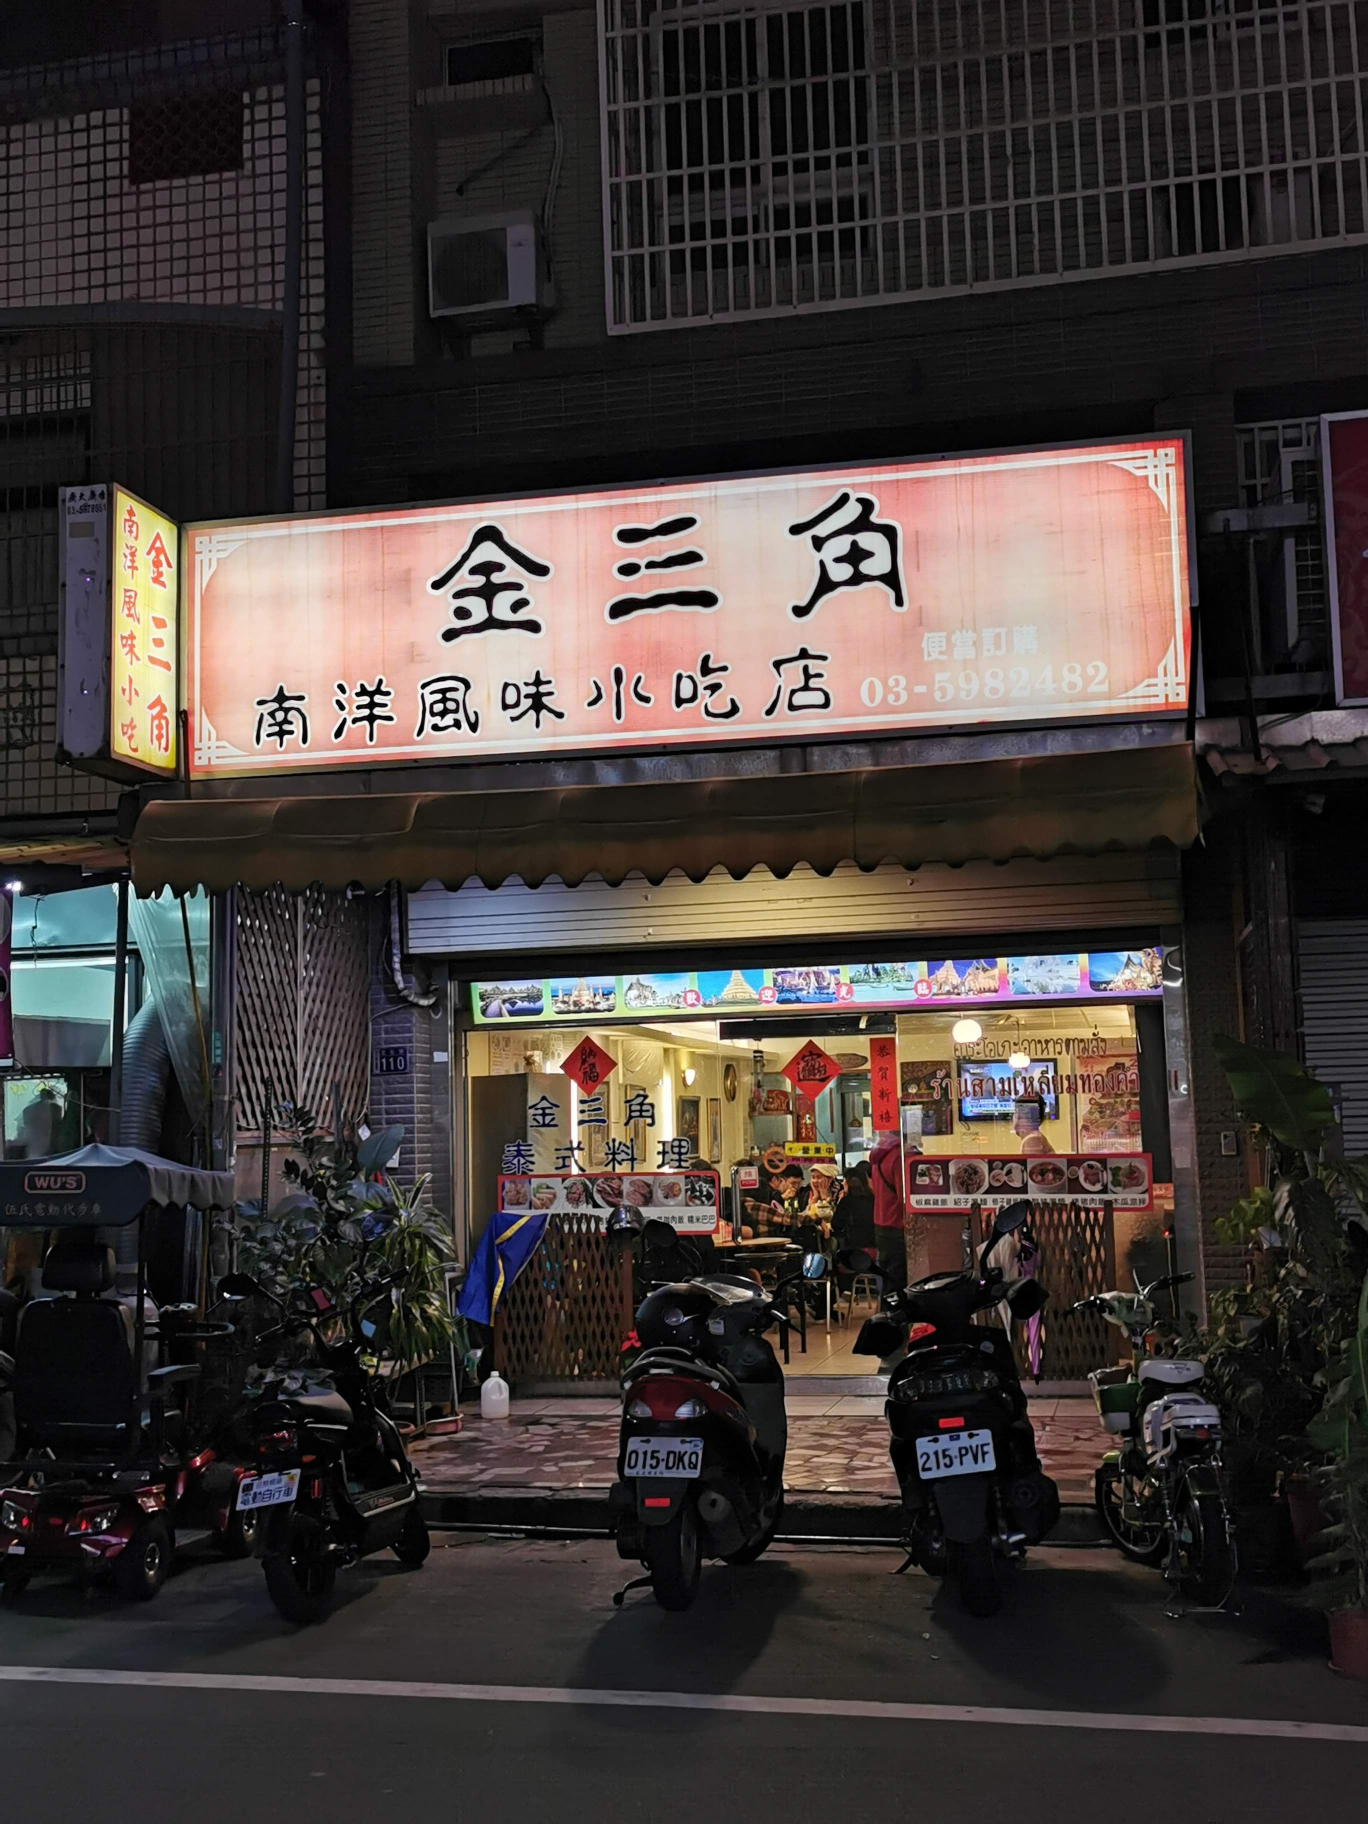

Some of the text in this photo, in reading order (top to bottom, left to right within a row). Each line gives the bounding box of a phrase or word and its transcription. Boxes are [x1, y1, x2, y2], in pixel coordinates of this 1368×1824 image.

[426, 488, 907, 642] 金三角
[120, 504, 141, 754] 南洋風味小吃
[145, 532, 173, 754] 金三角
[921, 624, 1040, 662] 便當訂購
[255, 647, 833, 749] 南洋風味小吃店
[860, 660, 1110, 708] 03-5982482
[380, 1056, 405, 1071] 110
[876, 1044, 893, 1124] 恭賀新禧
[527, 1091, 657, 1128] 金三角
[501, 1137, 692, 1175] 泰式料理
[34, 1176, 78, 1189] WU'S
[4, 1202, 102, 1217] 伍氏電動代步車
[240, 1486, 293, 1505] 電動自行車
